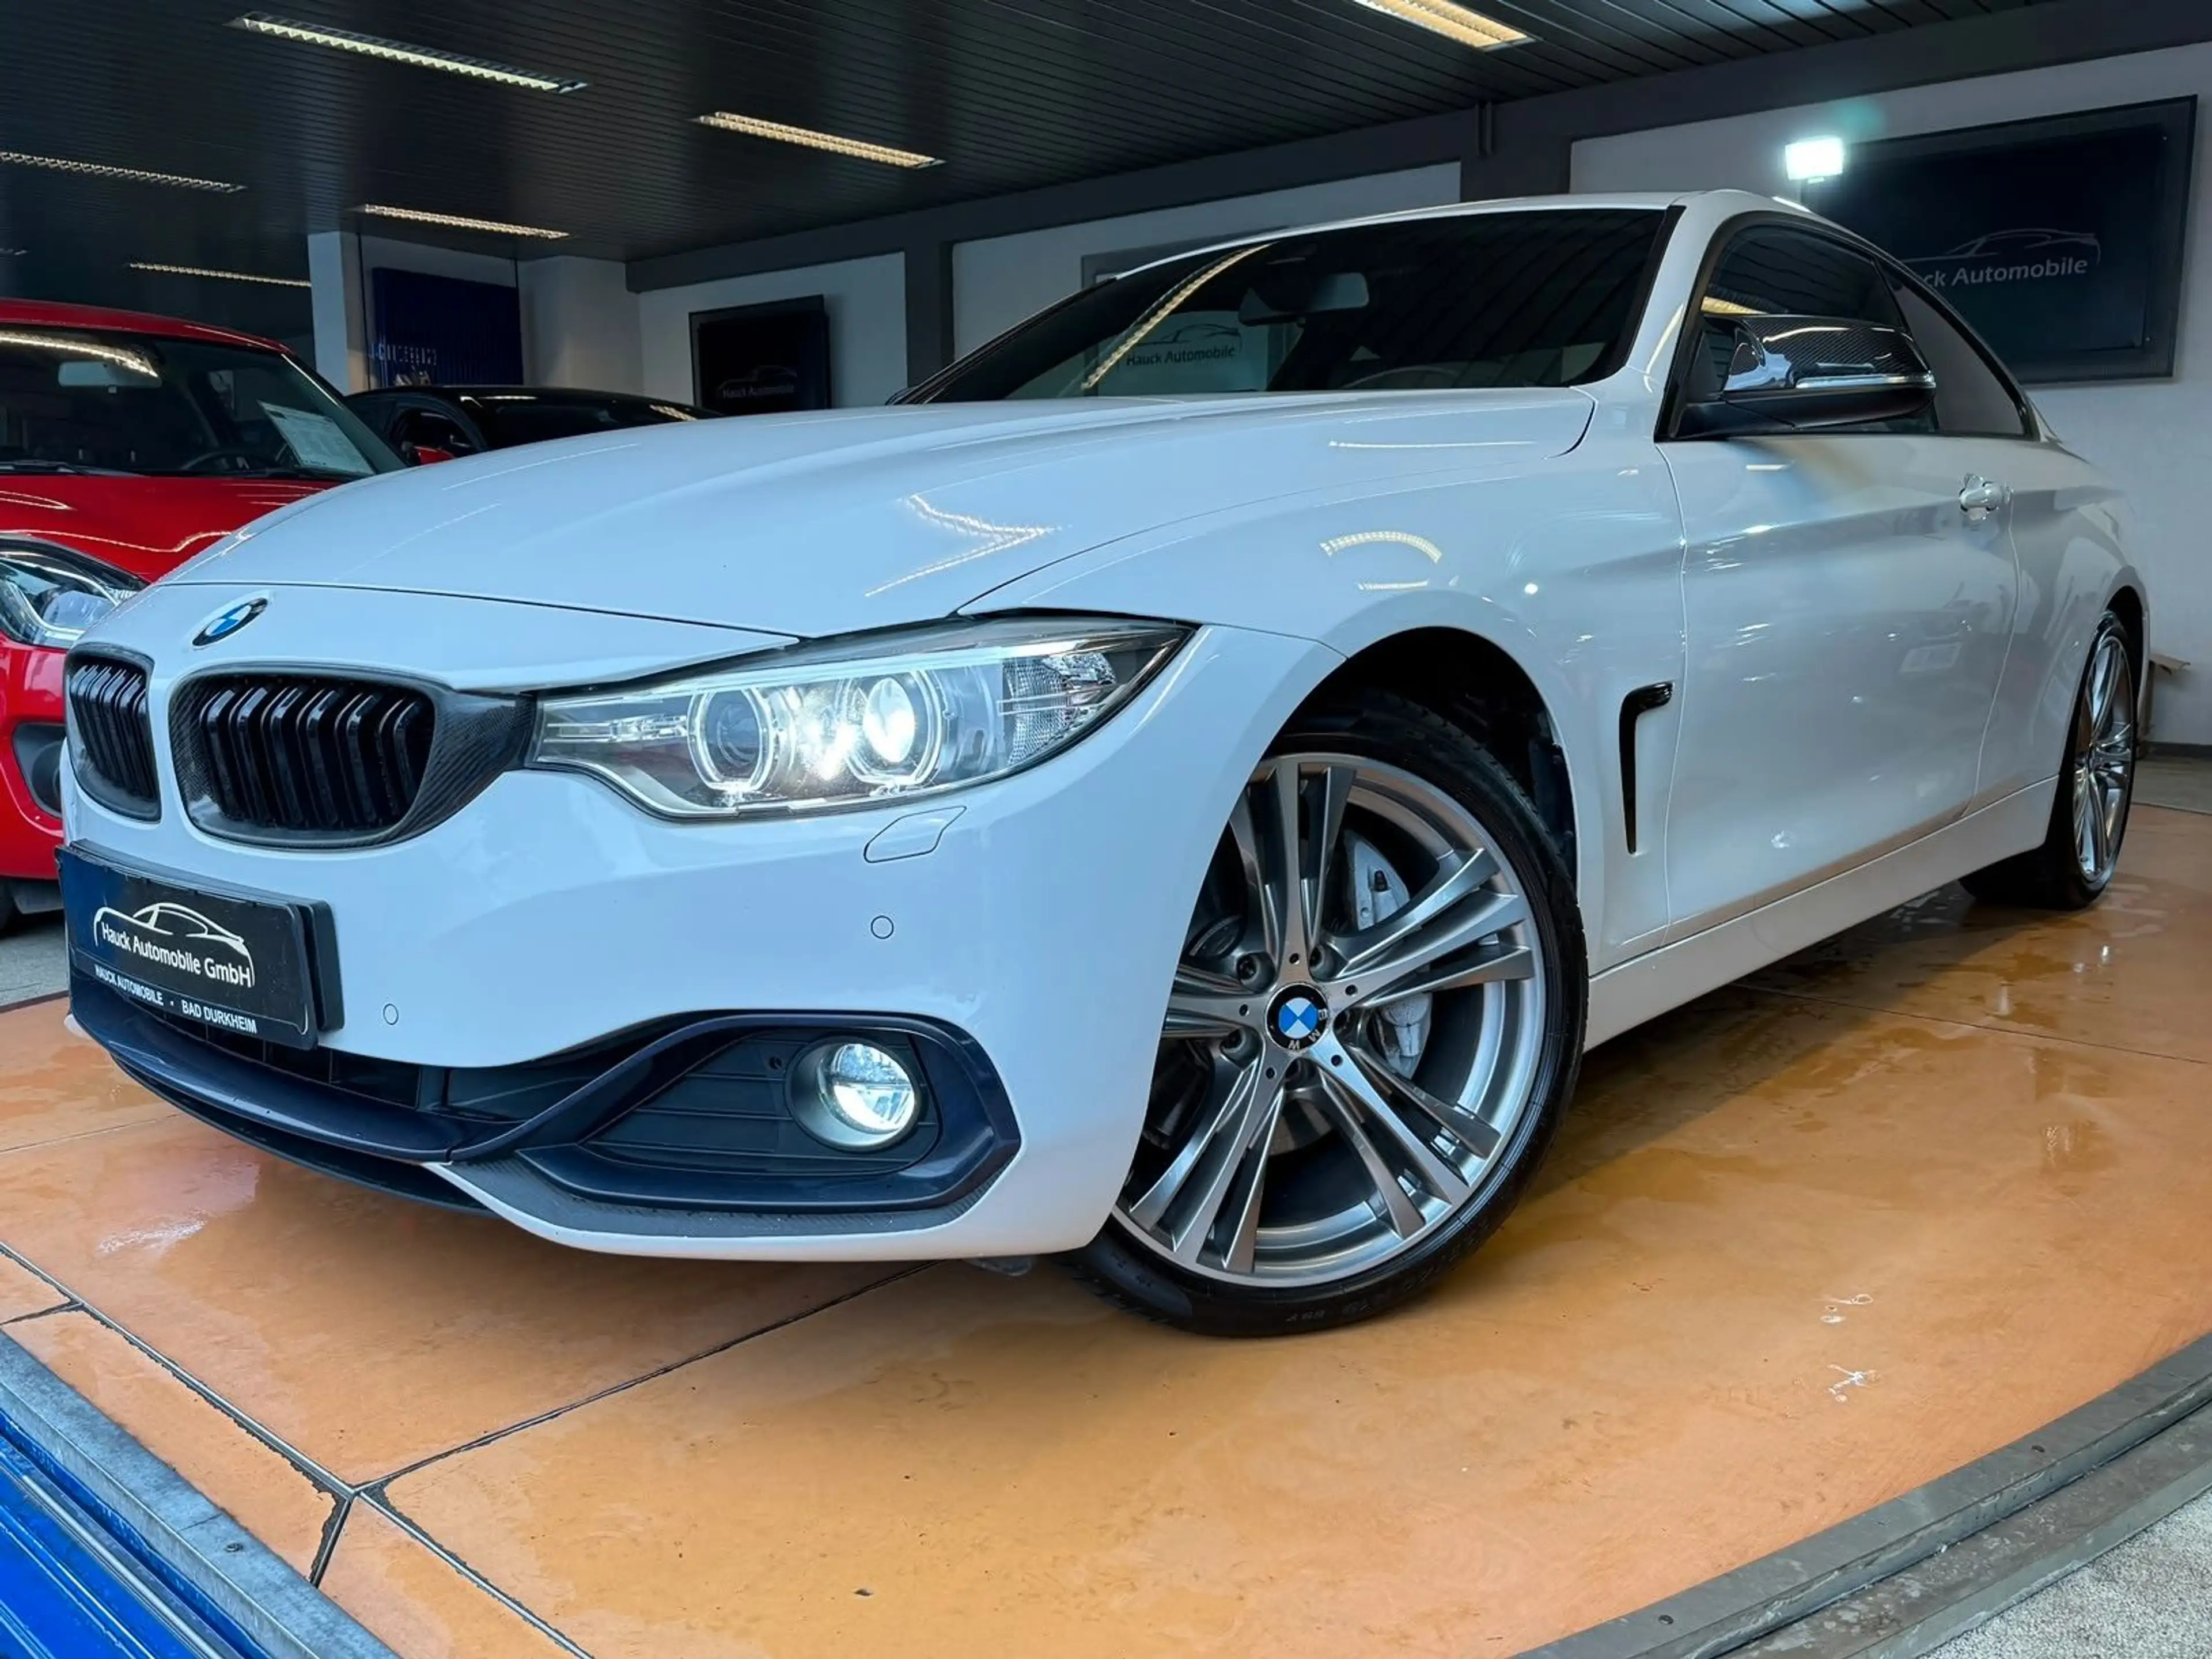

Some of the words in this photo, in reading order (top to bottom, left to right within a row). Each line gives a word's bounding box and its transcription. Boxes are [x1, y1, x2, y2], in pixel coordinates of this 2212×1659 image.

[1951, 257, 2088, 287] Automobile
[1126, 354, 1162, 366] Hauck
[1164, 344, 1236, 364] Automobile
[101, 921, 131, 952] Hauck
[133, 935, 201, 975] Automobile
[204, 957, 251, 988] GmbH
[118, 975, 164, 1006] AUTOMOBILE
[181, 999, 202, 1018] BAD
